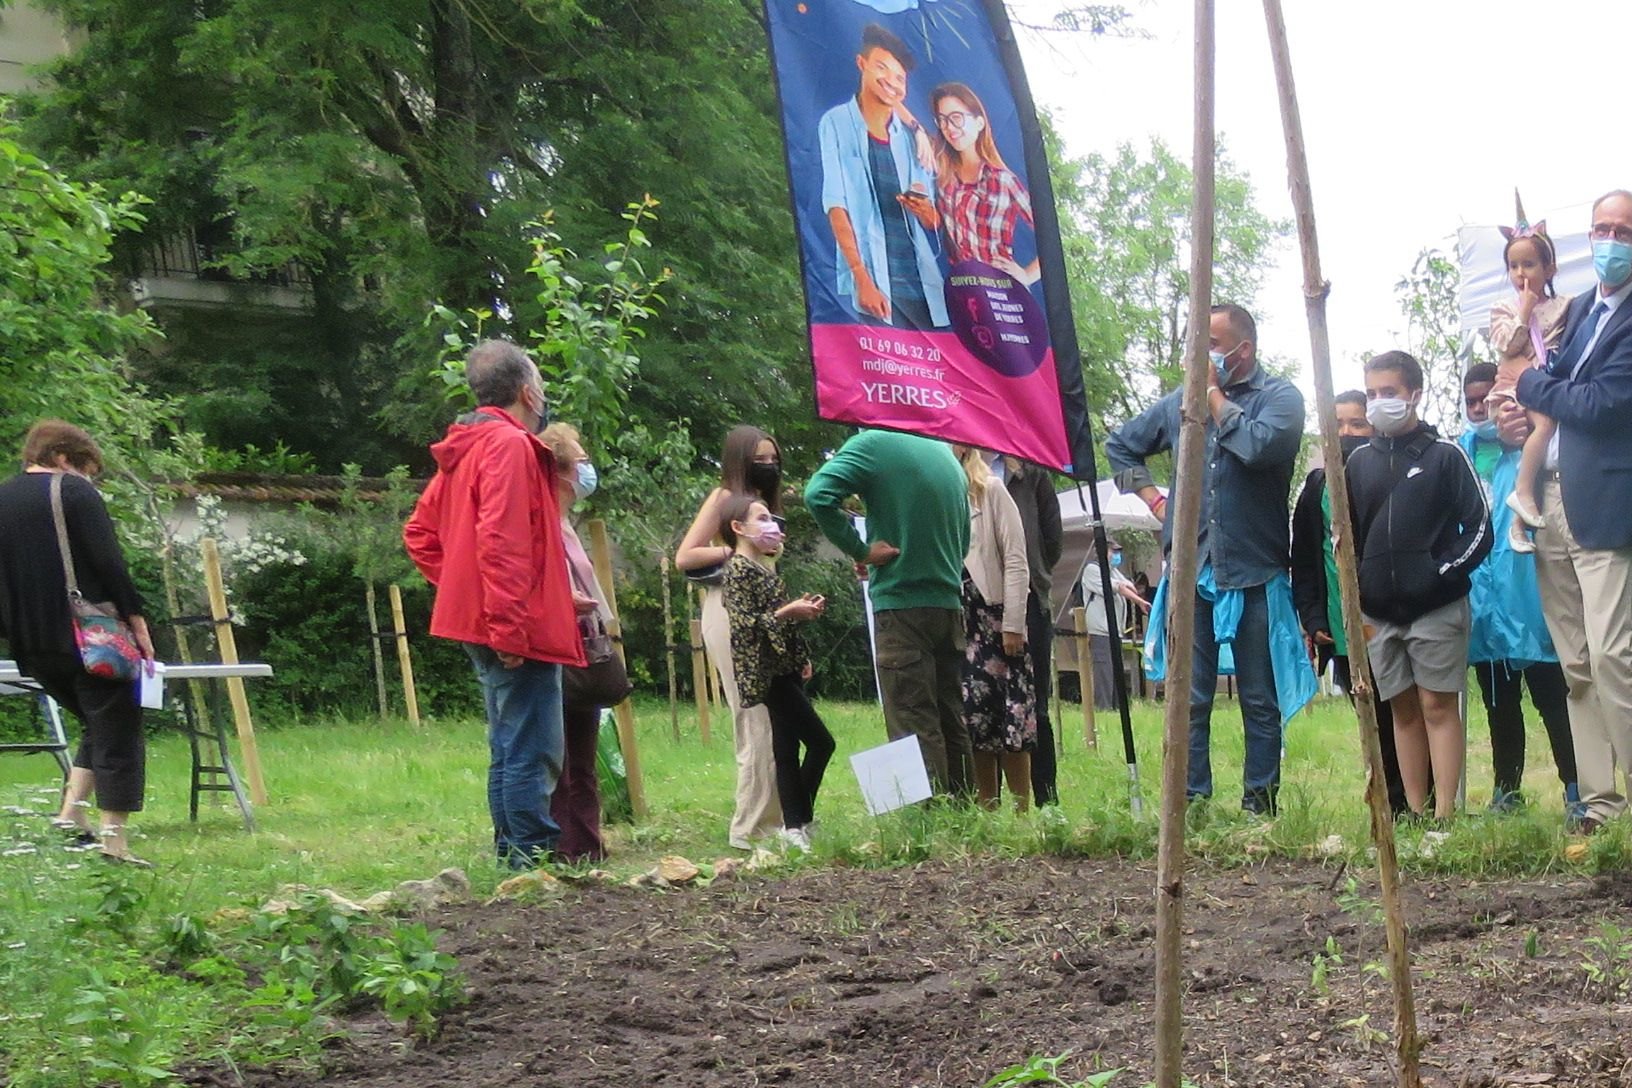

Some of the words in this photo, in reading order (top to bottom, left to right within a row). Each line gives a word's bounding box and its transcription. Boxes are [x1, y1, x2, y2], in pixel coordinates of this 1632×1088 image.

[860, 336, 874, 351] 01
[877, 339, 892, 354] 69
[894, 342, 909, 357] 06
[910, 345, 925, 361] 32
[925, 347, 941, 362] 20
[863, 358, 946, 382] mdj@yerres.fr
[861, 381, 948, 410] YERRES
